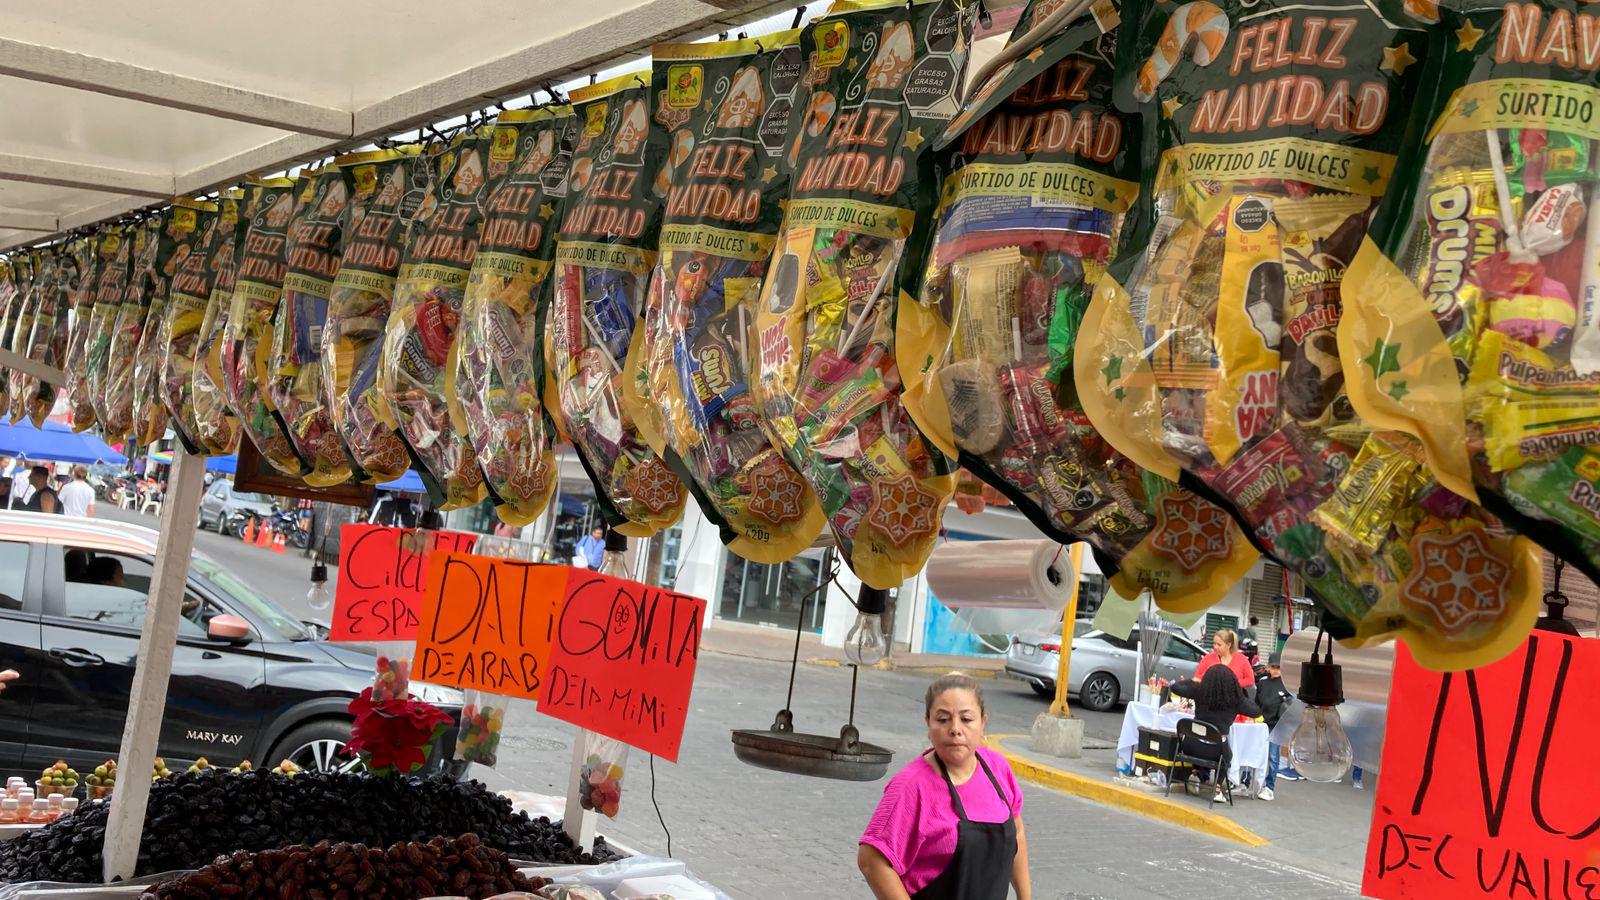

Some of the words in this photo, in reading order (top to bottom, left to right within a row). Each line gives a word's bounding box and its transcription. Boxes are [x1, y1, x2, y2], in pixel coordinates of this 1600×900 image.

[1229, 16, 1358, 77] FELIZ
[914, 78, 944, 87] GRASAS
[918, 69, 948, 78] EXCESO
[906, 87, 948, 96] SATURADAS
[1189, 75, 1389, 136] NAVIDAD
[1496, 92, 1593, 123] SURTIDO
[961, 110, 1124, 164] NAVIDAD
[686, 143, 754, 180] FELIZ
[1187, 152, 1252, 171] SURTIDO
[1258, 149, 1280, 168] DE
[1284, 148, 1350, 180] DULCES
[795, 151, 906, 196] NAVIDAD
[960, 173, 1015, 188] SURTIDO
[1020, 172, 1035, 188] DE
[1043, 172, 1095, 196] DULCES
[664, 183, 762, 224] NAVIDAD
[563, 205, 646, 240] NAVIDAD
[790, 206, 823, 221] SURTIDO
[824, 206, 837, 220] DE
[837, 206, 879, 228] DULCES
[246, 234, 285, 257] FELIZ
[692, 231, 703, 244] DE
[706, 232, 745, 252] DULCES
[1430, 186, 1469, 314] Drums
[497, 257, 525, 274] DULCES
[586, 247, 597, 262] DE
[300, 280, 328, 295] DULCES
[360, 274, 385, 290] DULCES
[433, 269, 462, 284] DULCES
[254, 288, 277, 300] DULCES
[186, 730, 220, 744] MARY
[221, 733, 243, 746] KAY
